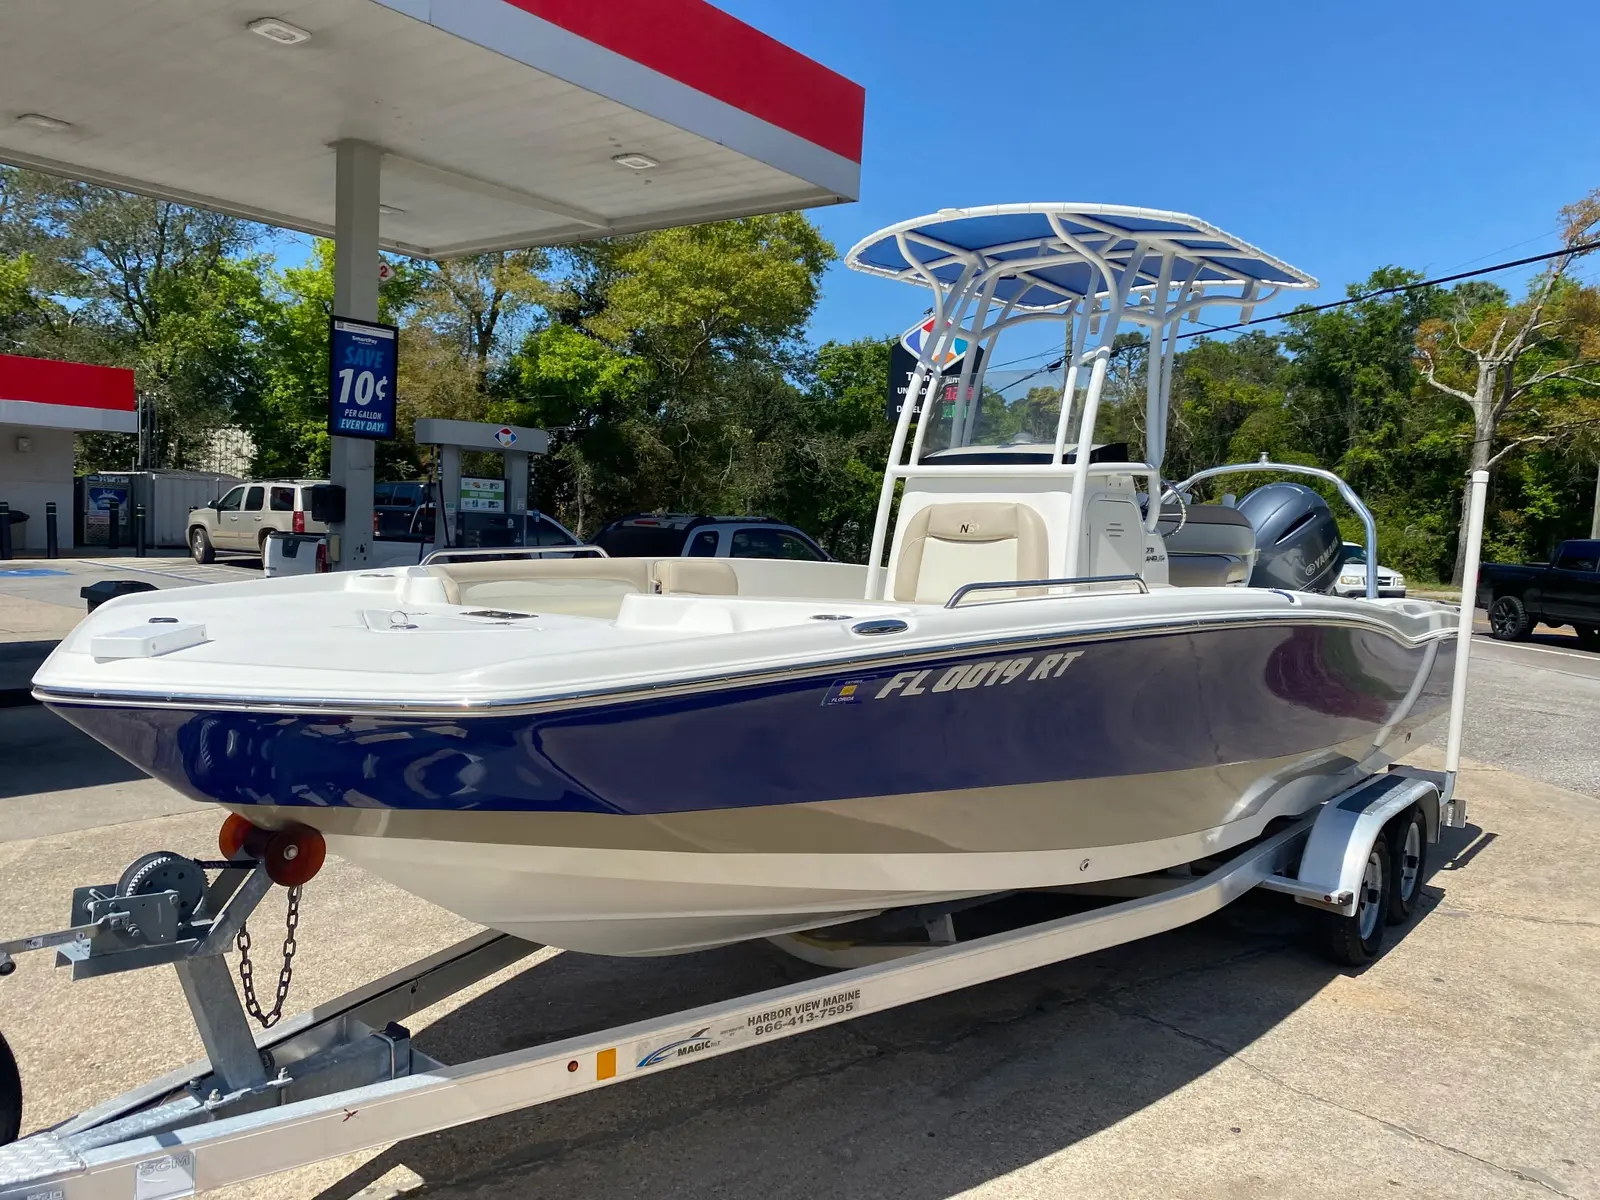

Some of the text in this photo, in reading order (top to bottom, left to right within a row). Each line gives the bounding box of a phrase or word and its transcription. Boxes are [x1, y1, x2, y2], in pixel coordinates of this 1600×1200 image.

[380, 265, 388, 278] 2
[344, 345, 385, 369] SAVE
[338, 368, 388, 406] 10¢
[341, 419, 385, 433] EVERY DAY!
[344, 408, 382, 420] PER GALLON
[874, 651, 1085, 699] FL 0019 RT
[748, 989, 861, 1026] HARBOR VIEW MARINE
[755, 1002, 854, 1036] 866-413-7595
